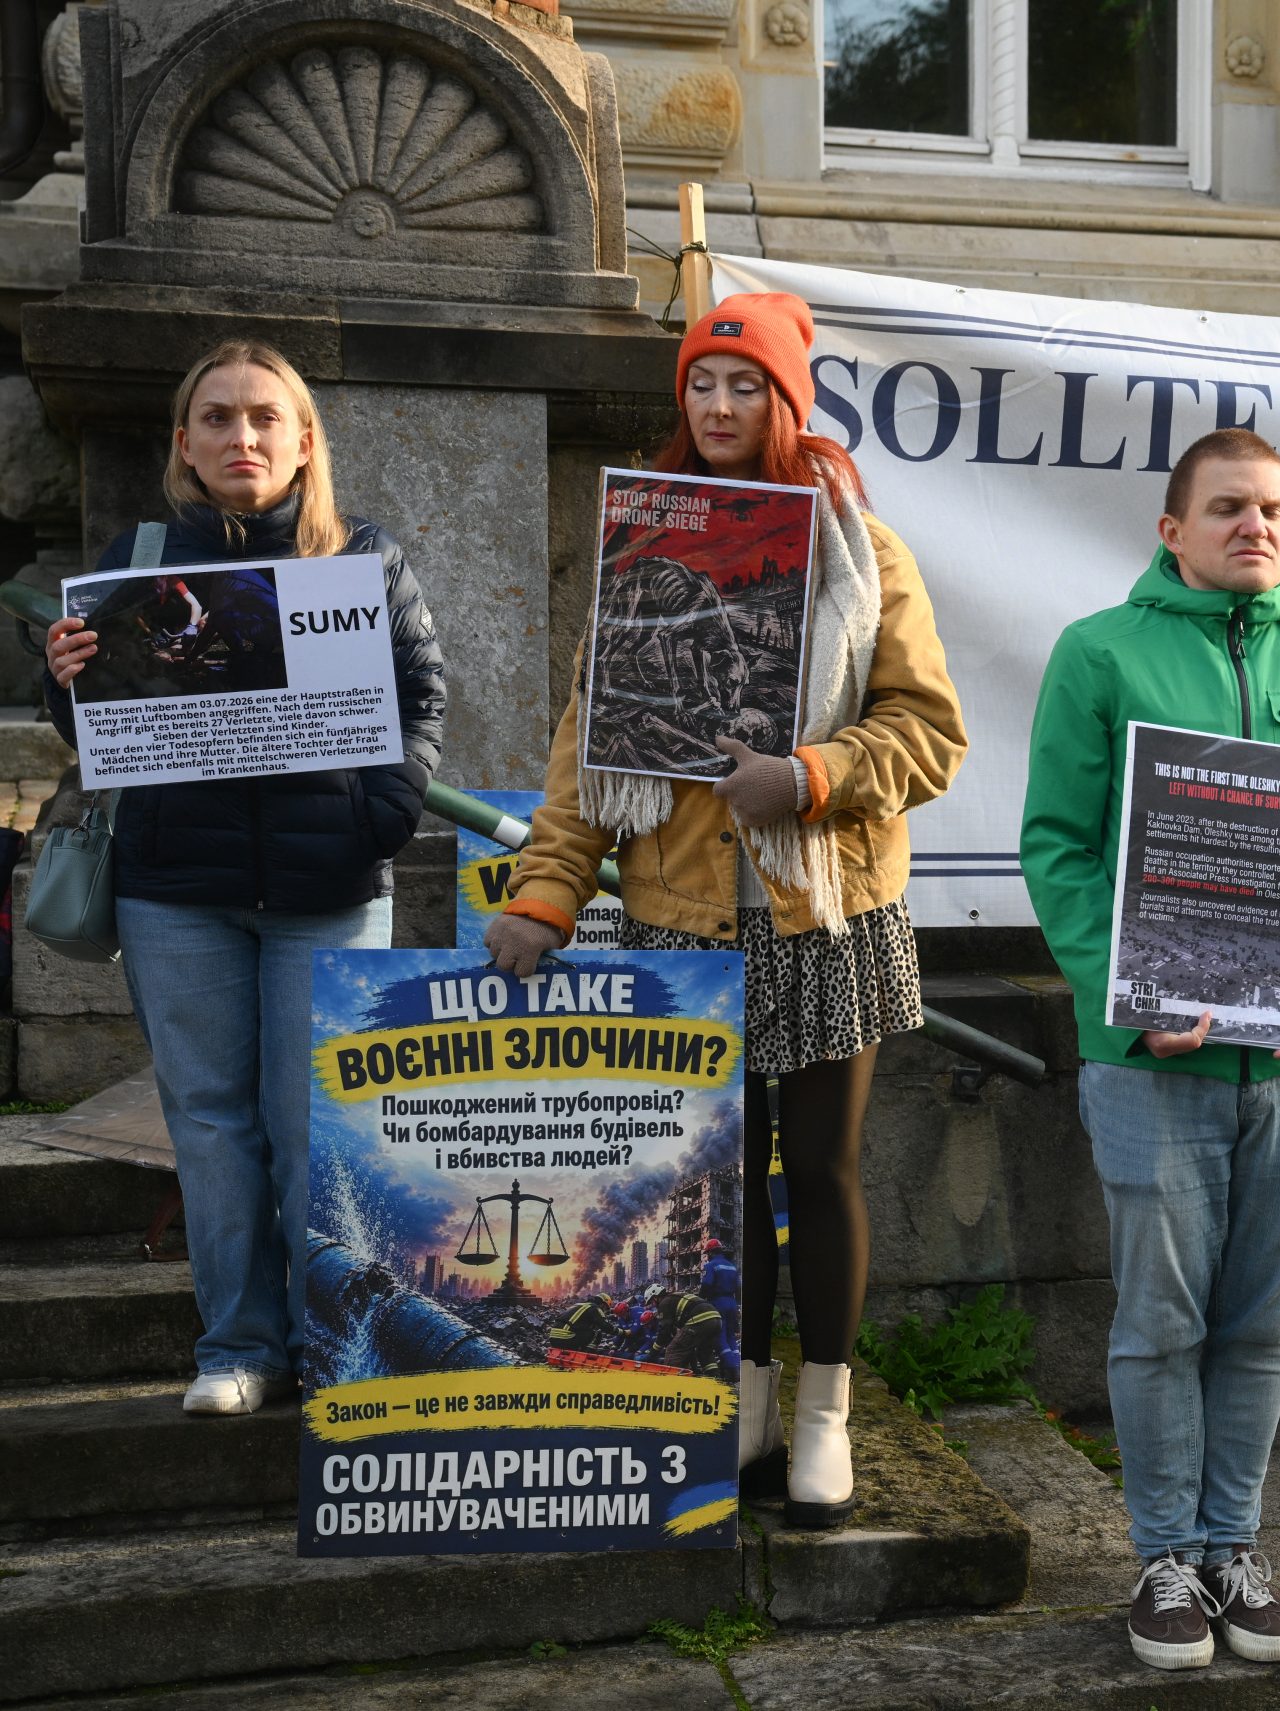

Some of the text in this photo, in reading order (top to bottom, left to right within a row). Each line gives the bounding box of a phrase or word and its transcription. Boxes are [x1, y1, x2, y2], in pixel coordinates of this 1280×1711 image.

[613, 490, 711, 514] STOP RUSSIAN
[611, 507, 708, 532] DRONE SIEGE
[289, 607, 380, 636] SUMY
[84, 686, 384, 717] Die Russen haben am 03.07.2026 eine der Hauptstraßen in
[88, 697, 382, 728] Sumy mit Luftbomben angegriffen. Nach dem russischen
[95, 725, 132, 737] Angriff
[135, 724, 155, 735] gibt
[172, 720, 209, 730] bereits
[211, 718, 223, 727] 27
[225, 715, 275, 728] Verletzte,
[278, 712, 302, 722] viele
[305, 711, 336, 719] davon
[339, 707, 378, 717] schwer.
[1155, 762, 1171, 777] THIS
[1172, 765, 1180, 778] IS
[1181, 766, 1195, 780] NOT
[1197, 768, 1210, 783] THE
[1210, 770, 1230, 785] FIRST
[1232, 773, 1249, 788] TIME
[1249, 776, 1280, 793] OLESHKY
[1169, 782, 1185, 795] LEFT
[1187, 784, 1218, 800] WITHOUT
[1220, 789, 1225, 801] A
[1226, 790, 1253, 806] CHANCE
[1255, 794, 1264, 806] OF
[1147, 810, 1155, 819] In
[1156, 812, 1174, 822] June
[1176, 814, 1196, 826] 2023,
[1198, 817, 1215, 827] after
[1216, 820, 1228, 829] the
[1229, 822, 1269, 834] destruction
[1271, 828, 1278, 836] of
[429, 973, 635, 1023] ЩО ТАКЕ
[1130, 982, 1154, 996] STRI
[1134, 996, 1160, 1012] CHKA
[337, 1026, 728, 1091] ВОЄННІ ЗЛОЧИНИ?
[382, 1090, 685, 1121] Пошкоджений трубопровід?
[383, 1117, 684, 1146] Чи бомбардування будівель
[448, 1147, 546, 1168] вбивства
[551, 1144, 633, 1169] людей?
[326, 1400, 388, 1424] Закон
[416, 1396, 440, 1417] це
[445, 1394, 469, 1412] не
[474, 1391, 551, 1413] завжди
[556, 1390, 720, 1416] справедливість!
[323, 1446, 647, 1498] СОЛІДАРНІСТЬ
[315, 1493, 650, 1536] ОБВИНУВАЧЕНИМИ
